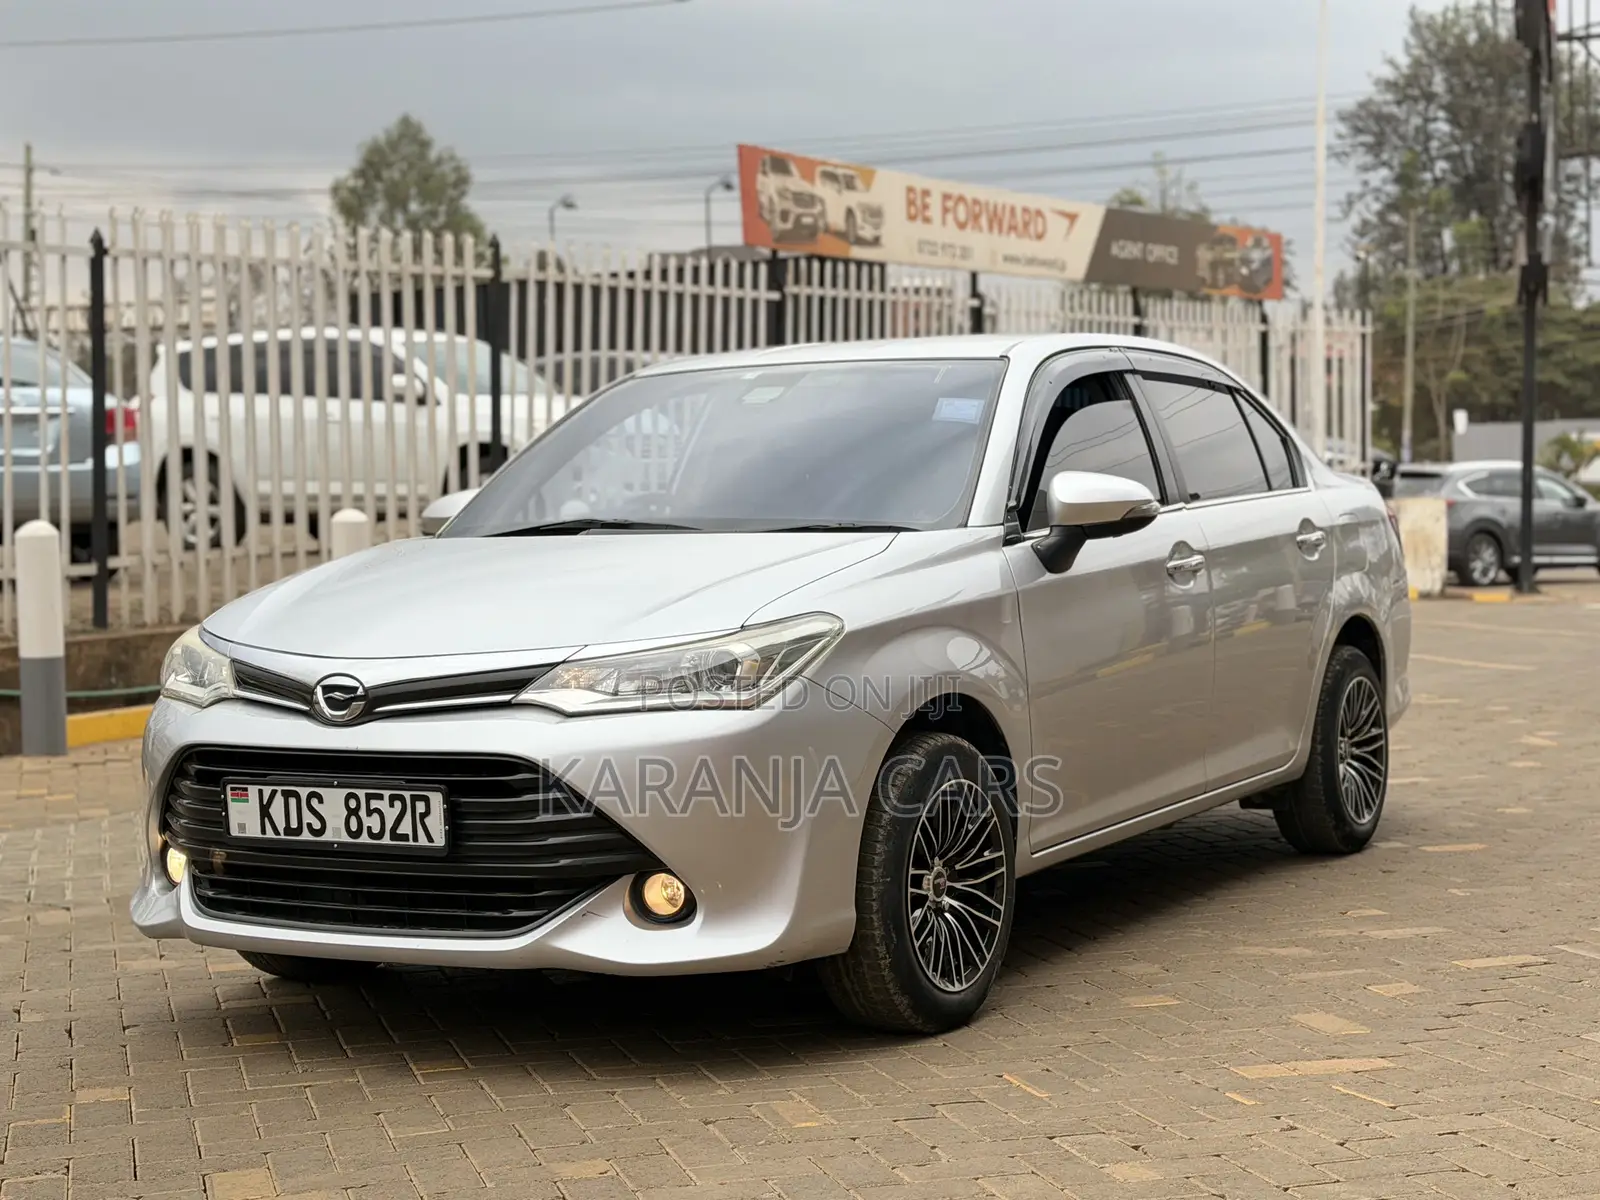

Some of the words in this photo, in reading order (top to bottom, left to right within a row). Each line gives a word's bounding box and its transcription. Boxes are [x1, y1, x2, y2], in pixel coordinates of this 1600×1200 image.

[905, 186, 933, 225] BE
[940, 191, 1048, 242] FORWARD
[1110, 239, 1144, 260] AGENT
[1145, 242, 1180, 266] OFFICE
[257, 788, 328, 838] KDS
[343, 791, 435, 844] 852R
